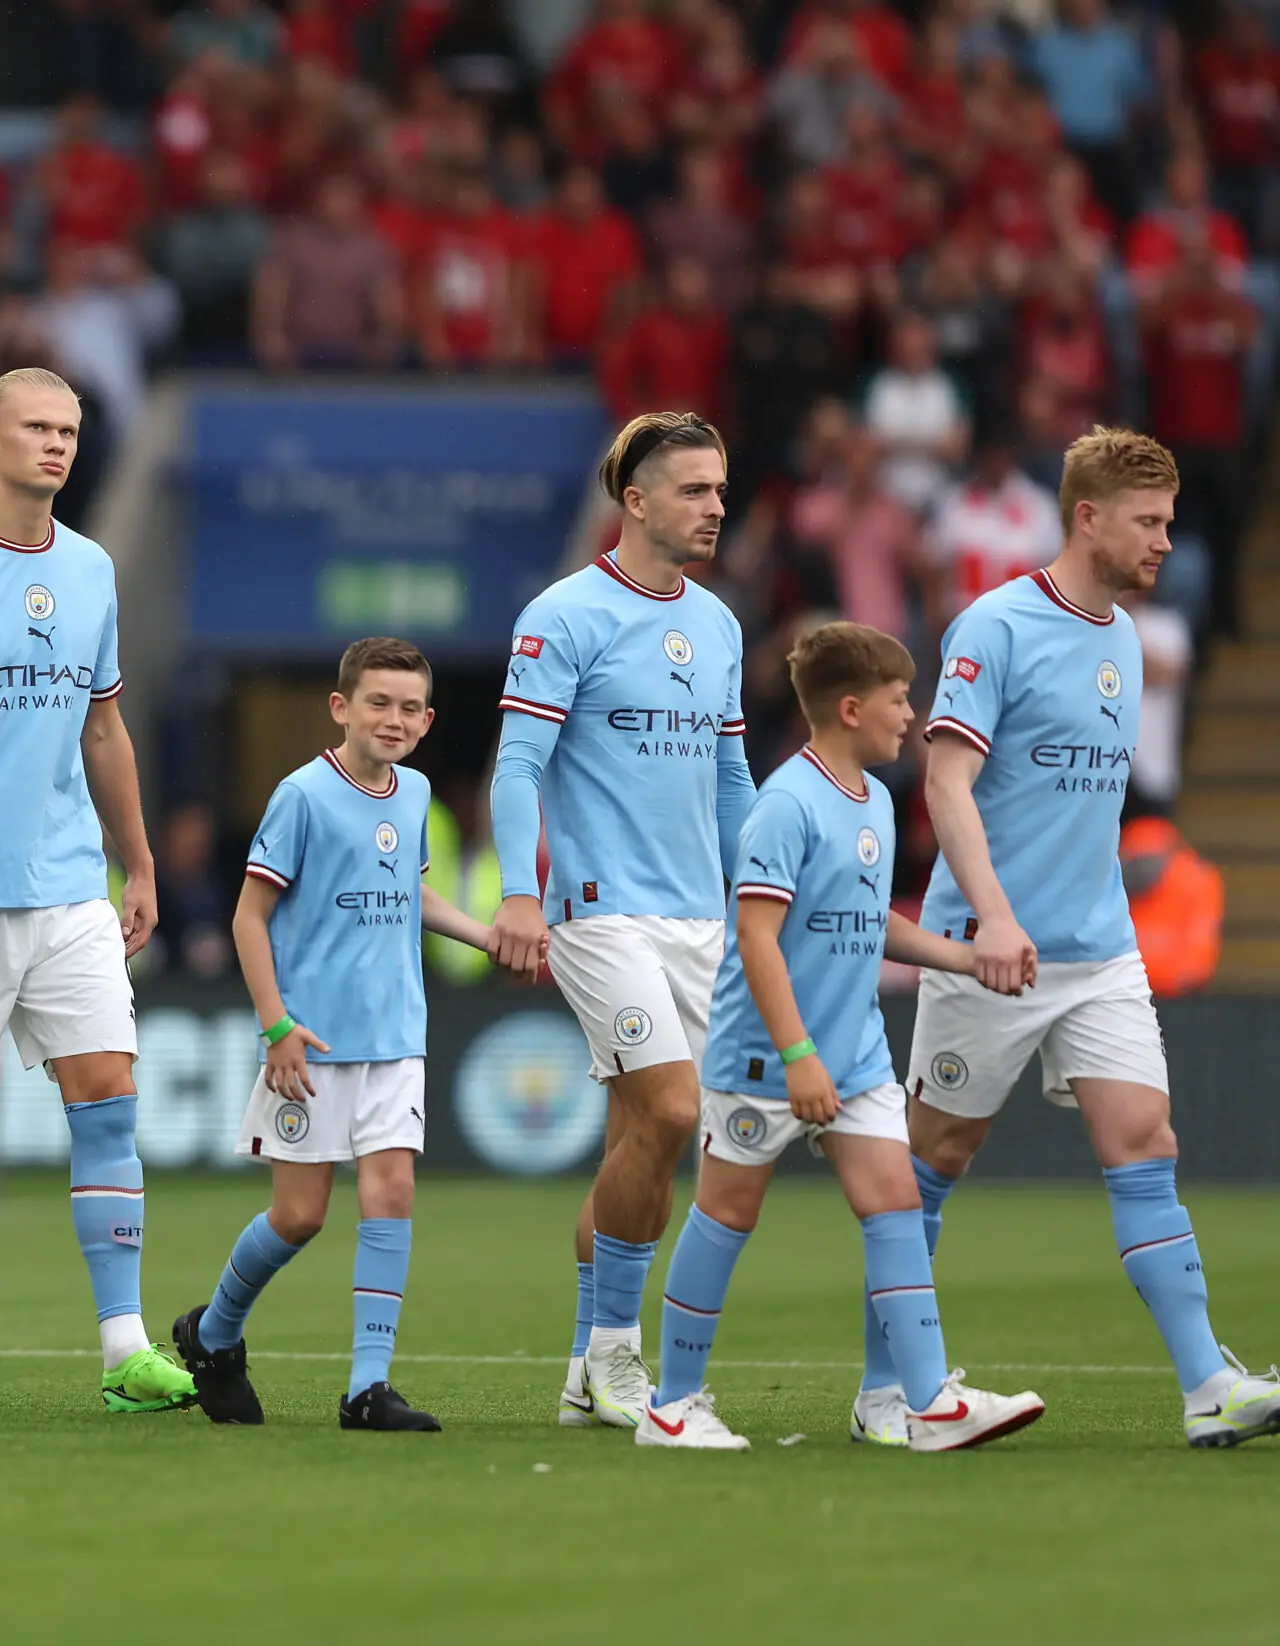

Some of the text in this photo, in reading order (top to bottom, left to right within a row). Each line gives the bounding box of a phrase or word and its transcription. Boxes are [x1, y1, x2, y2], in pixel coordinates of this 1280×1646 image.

[1030, 744, 1135, 770] ETIHA
[1055, 777, 1125, 793] AIRWAY
[335, 890, 412, 909] ETIHA
[829, 940, 878, 956] AIRW
[114, 1226, 144, 1237] CIT
